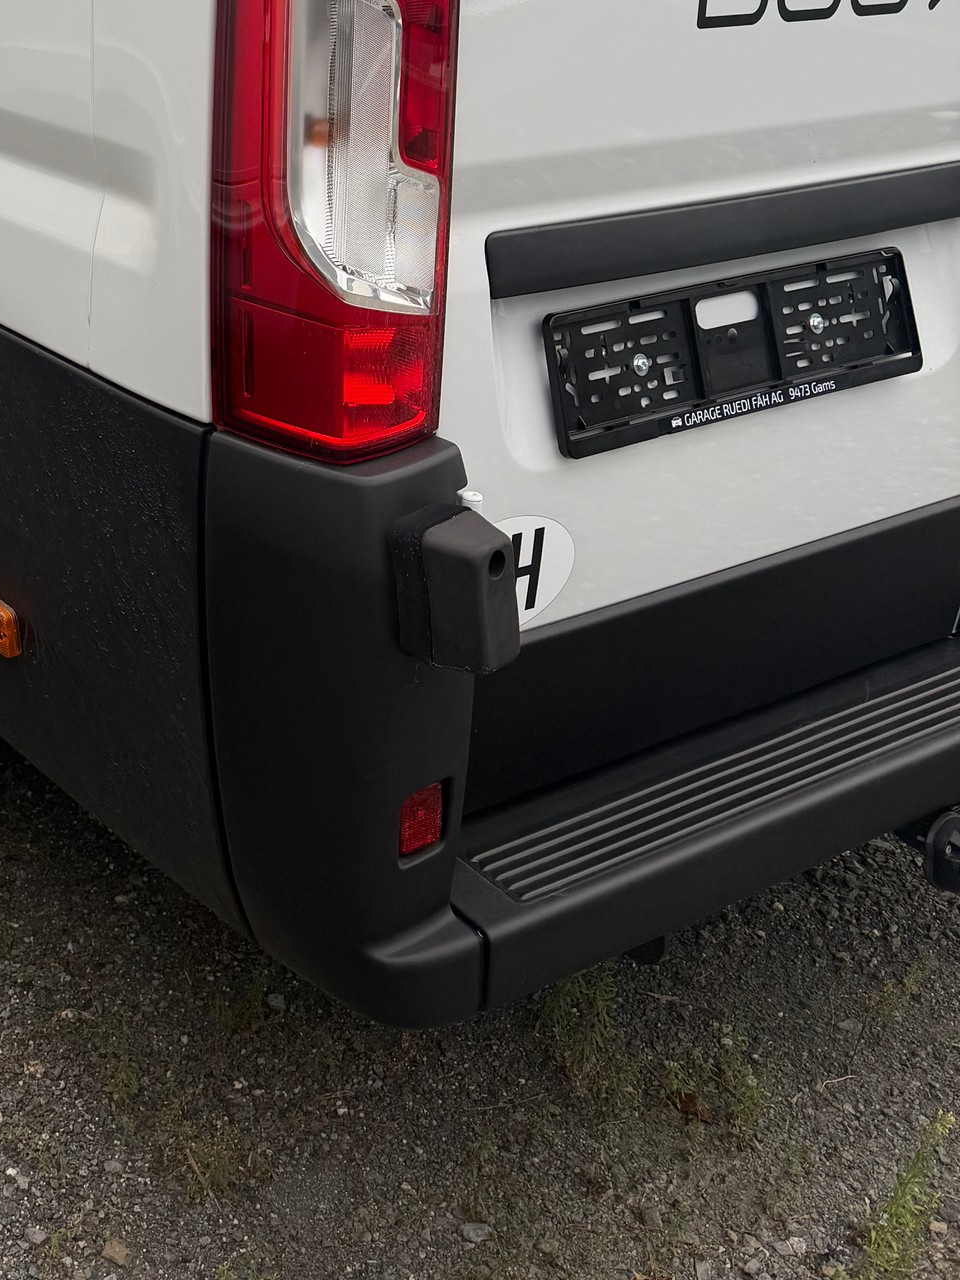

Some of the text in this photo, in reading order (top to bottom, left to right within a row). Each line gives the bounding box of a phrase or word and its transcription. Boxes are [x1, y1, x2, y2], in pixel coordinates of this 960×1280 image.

[684, 380, 836, 426] GARAGE RUEDI FÄH AG 9473 Gams
[511, 526, 545, 611] H
